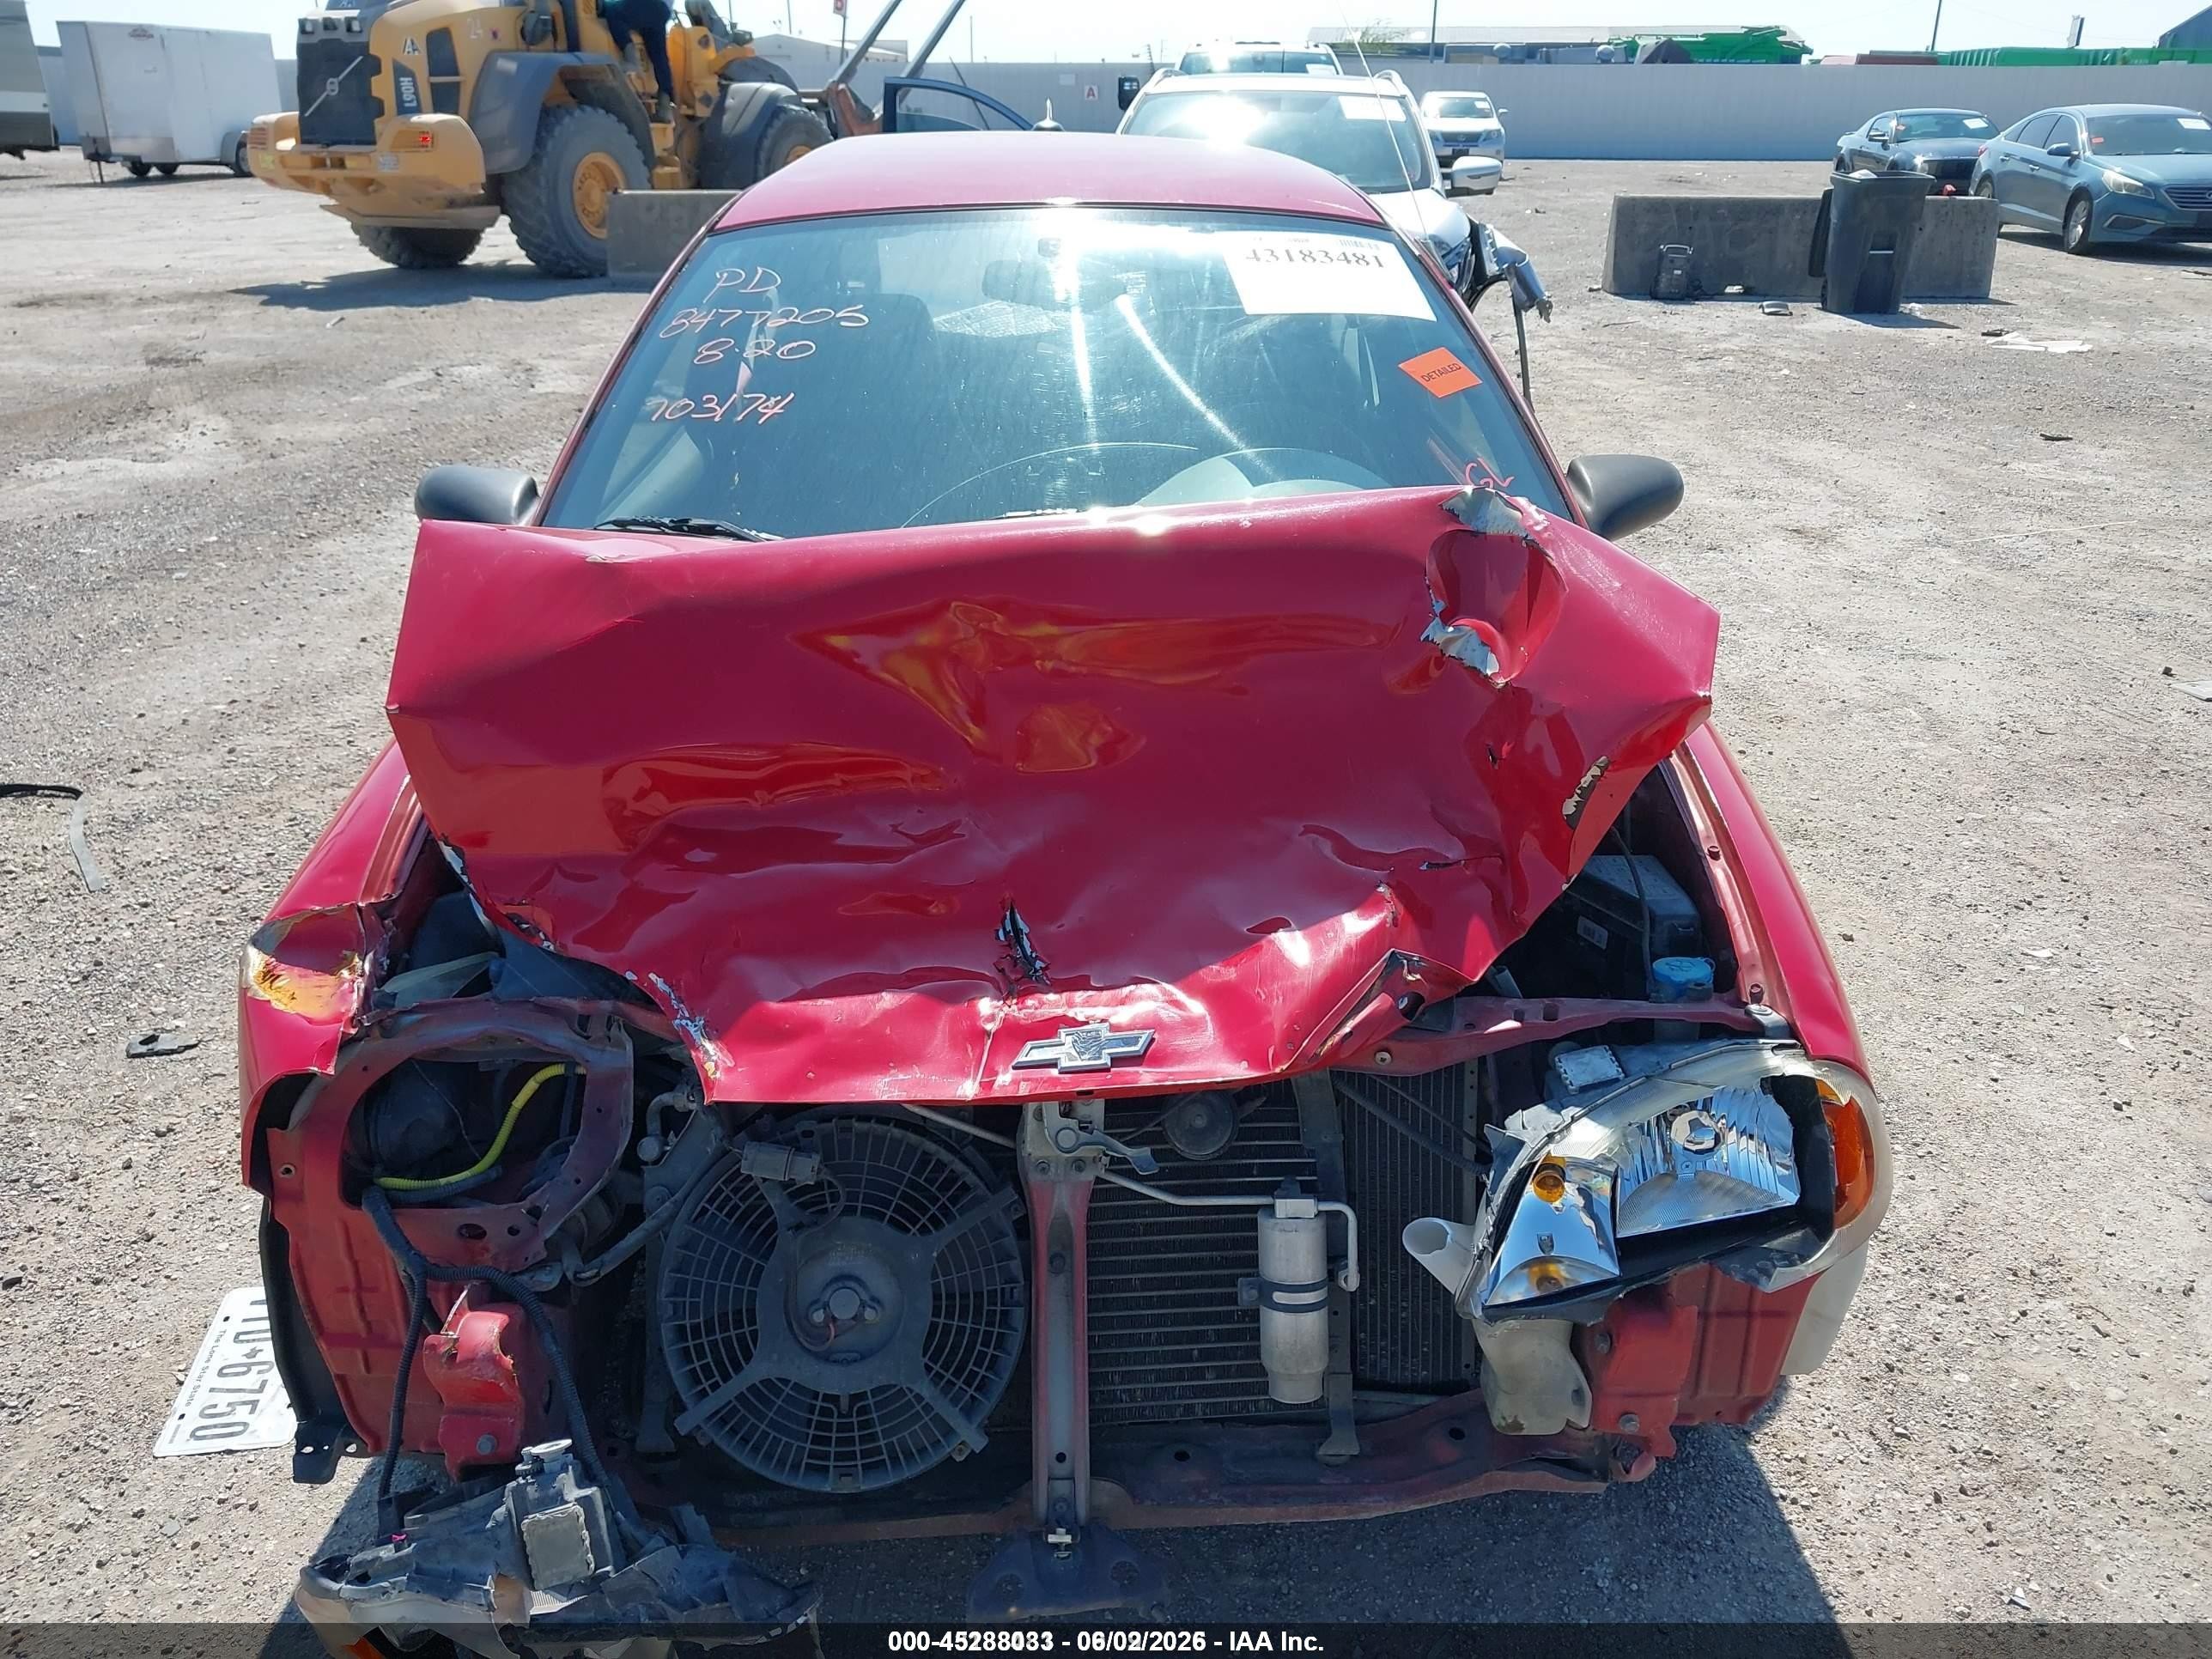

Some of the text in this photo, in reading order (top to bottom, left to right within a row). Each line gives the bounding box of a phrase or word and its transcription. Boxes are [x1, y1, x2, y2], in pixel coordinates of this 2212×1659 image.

[398, 76, 418, 107] L90H
[703, 266, 782, 303] PD
[1420, 362, 1462, 382] DETAILED
